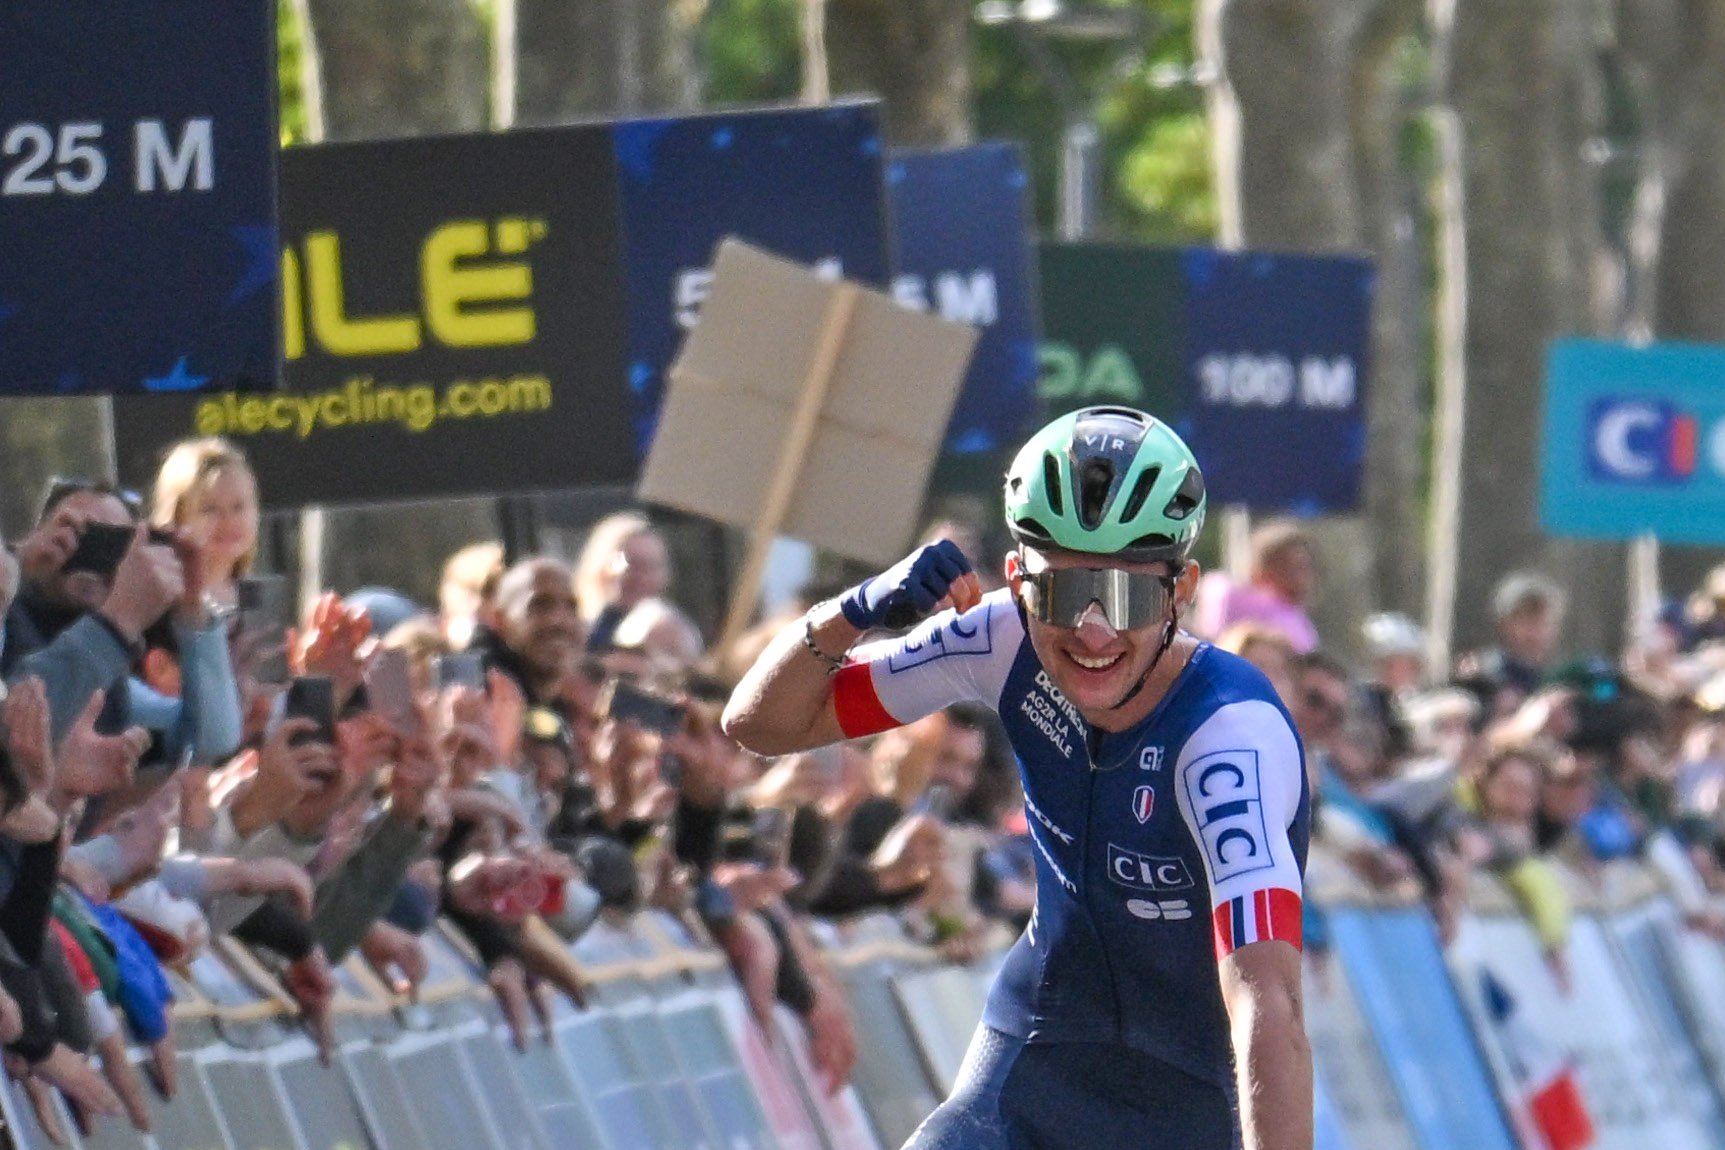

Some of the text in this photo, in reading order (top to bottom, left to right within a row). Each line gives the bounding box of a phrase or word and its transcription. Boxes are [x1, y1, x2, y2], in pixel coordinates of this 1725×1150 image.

[133, 118, 214, 193] M
[935, 266, 998, 326] M
[195, 372, 552, 440] alecycling.com
[1201, 352, 1355, 408] 100 M
[1021, 700, 1073, 759] MONDIALE
[1026, 690, 1069, 738] AG2R LA
[1199, 762, 1257, 865] CIC
[1114, 856, 1182, 885] CIC
